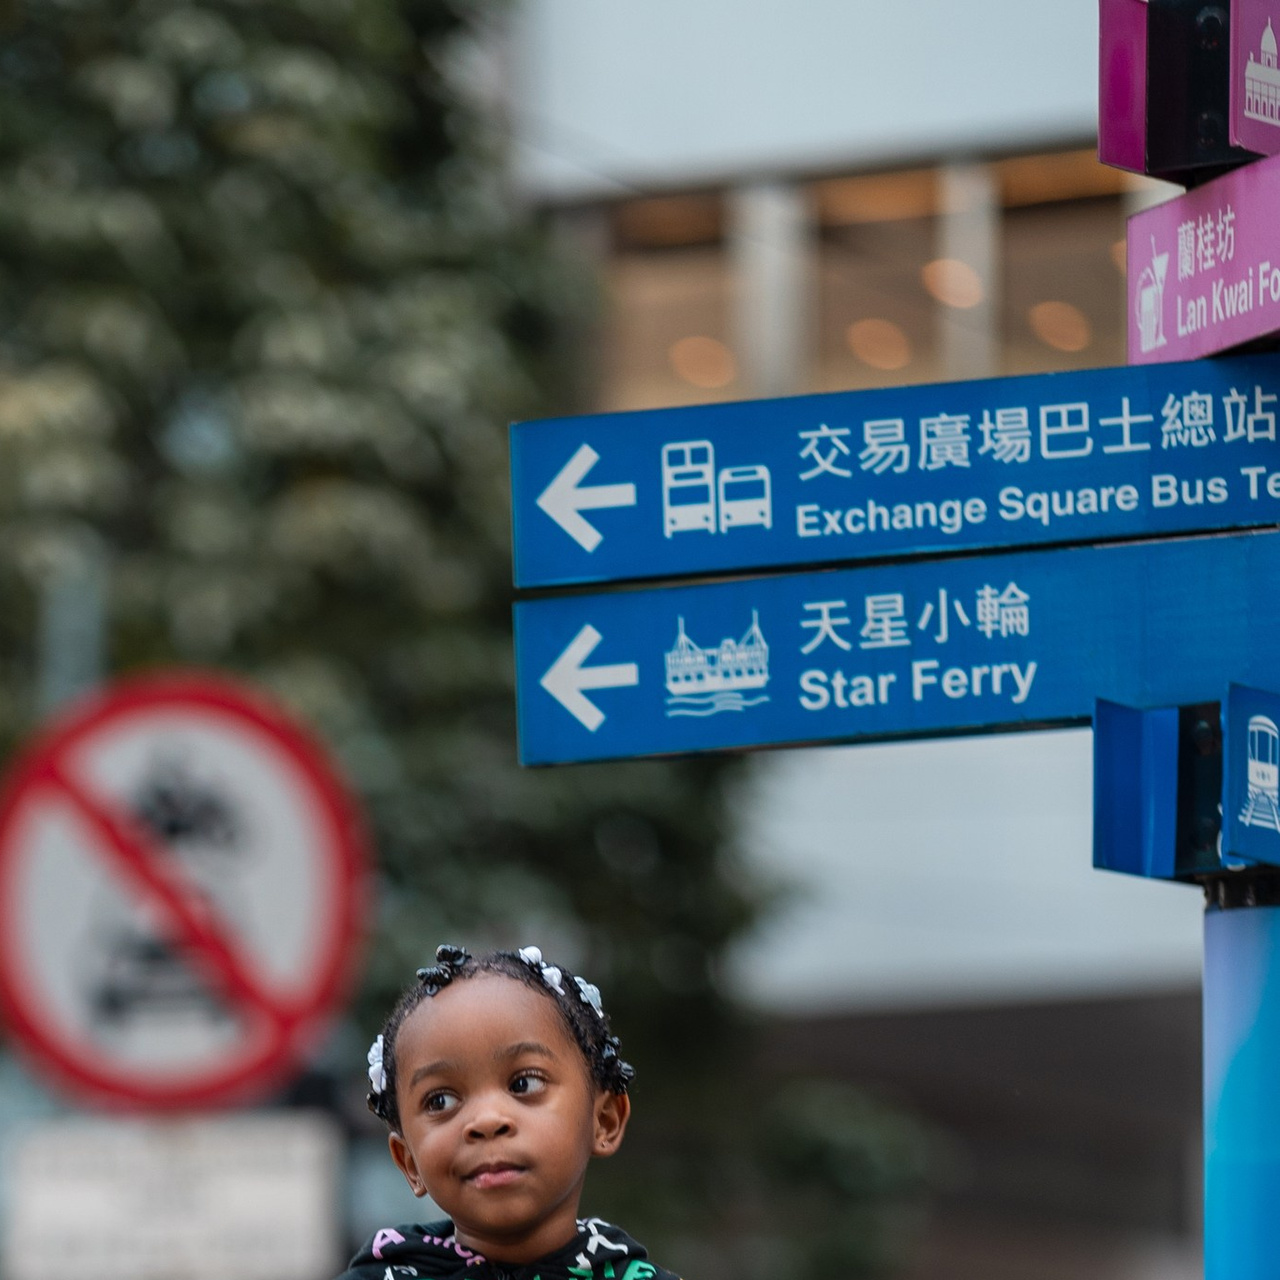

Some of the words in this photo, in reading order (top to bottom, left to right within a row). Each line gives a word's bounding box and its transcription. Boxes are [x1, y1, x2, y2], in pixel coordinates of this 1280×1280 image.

[1176, 203, 1236, 283] 蘭桂坊
[1177, 295, 1208, 338] Lan
[1212, 266, 1254, 325] Kwai
[798, 385, 1279, 482] 交易廣場巴士總站
[796, 497, 988, 537] Exchange
[998, 484, 1139, 526] Square
[1151, 473, 1228, 507] Bus
[799, 580, 1031, 656] 天星小輪
[798, 669, 897, 711] Star
[911, 659, 1038, 705] Ferry
